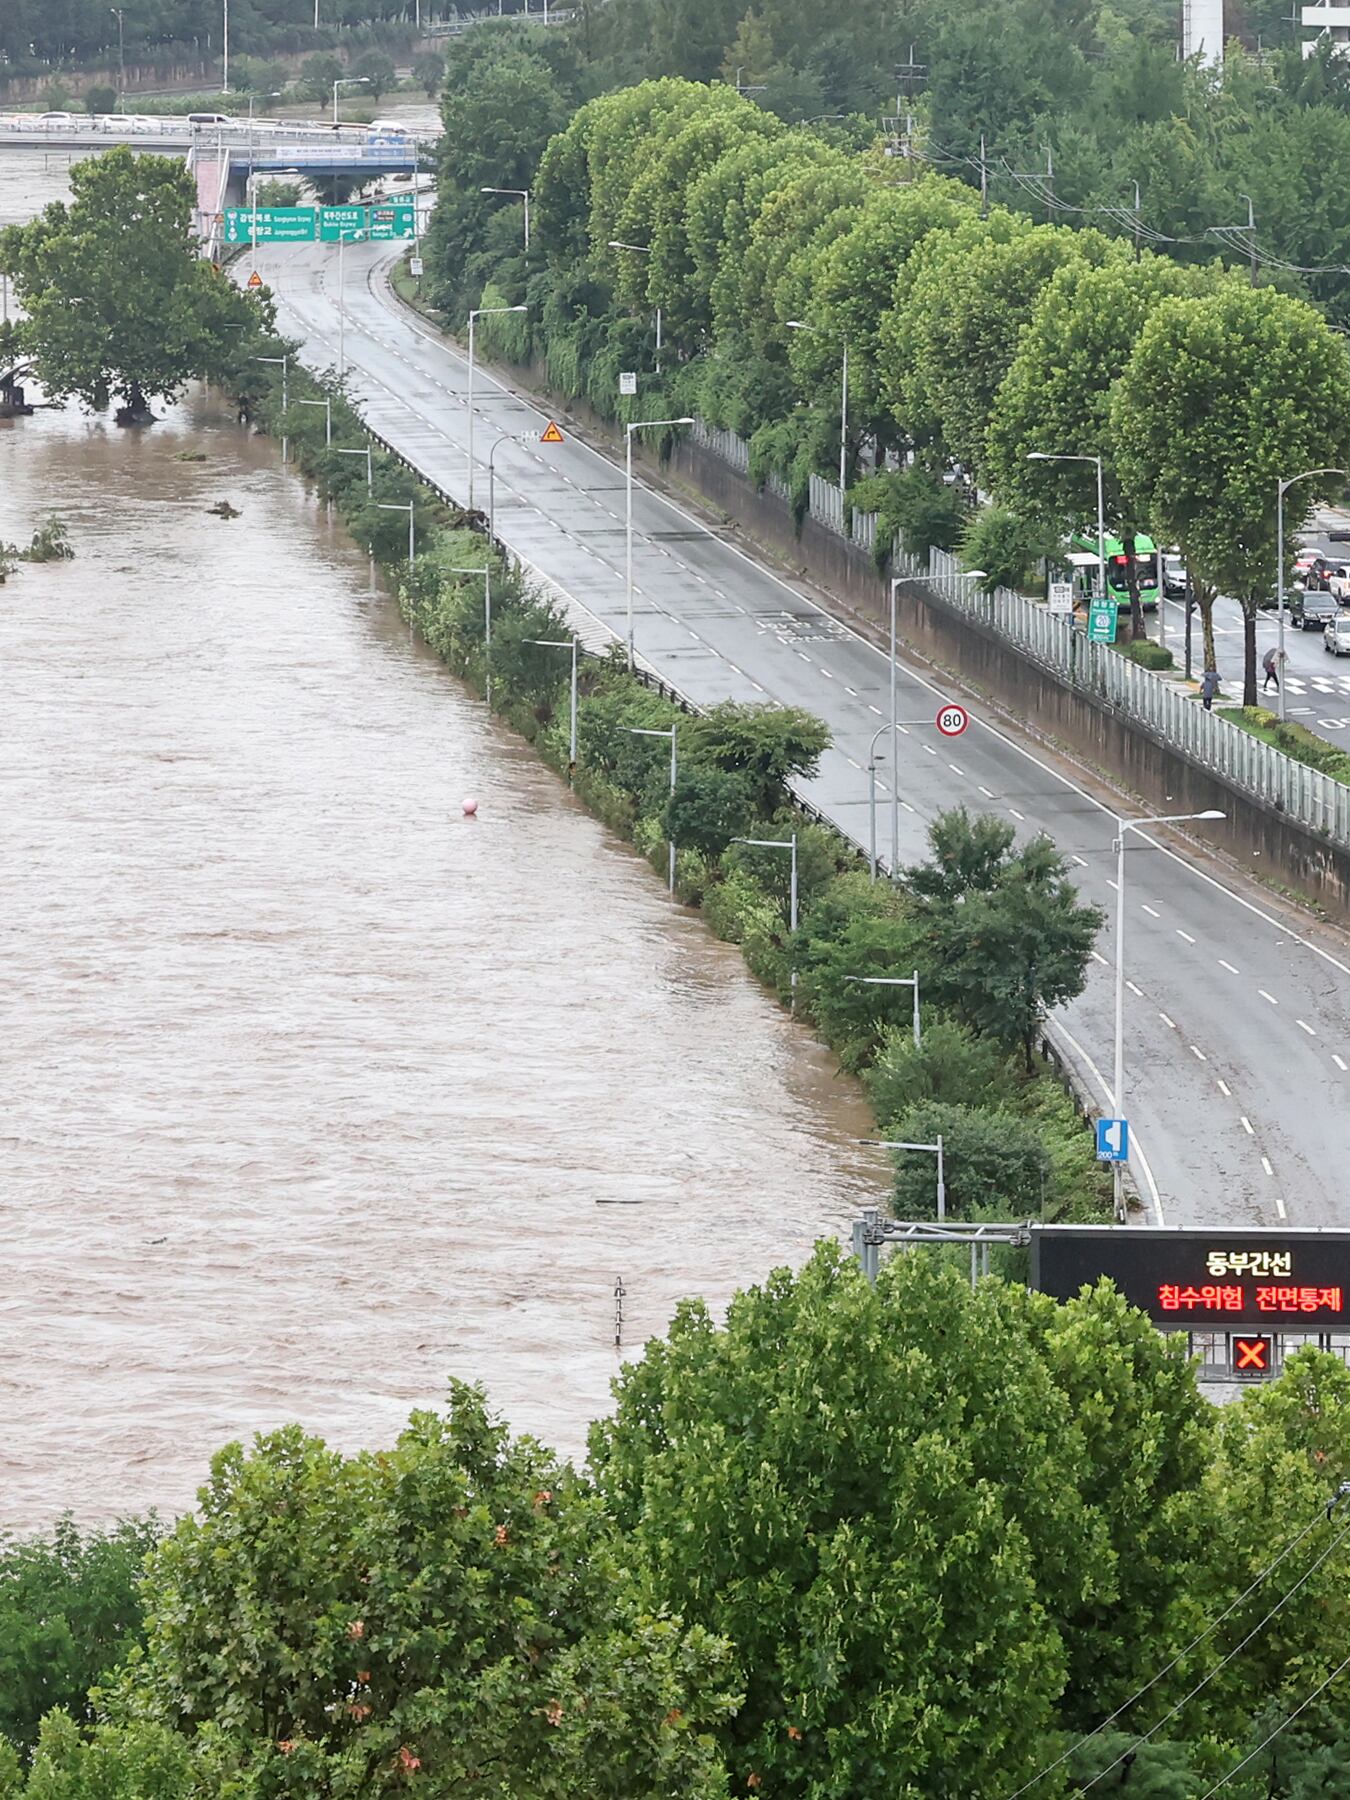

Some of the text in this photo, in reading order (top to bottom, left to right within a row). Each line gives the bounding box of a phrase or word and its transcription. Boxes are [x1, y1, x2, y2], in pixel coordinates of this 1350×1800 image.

[943, 713, 961, 727] 80
[1205, 1251, 1292, 1277] 동부간선
[1158, 1284, 1342, 1312] 침수위험 전면통제
